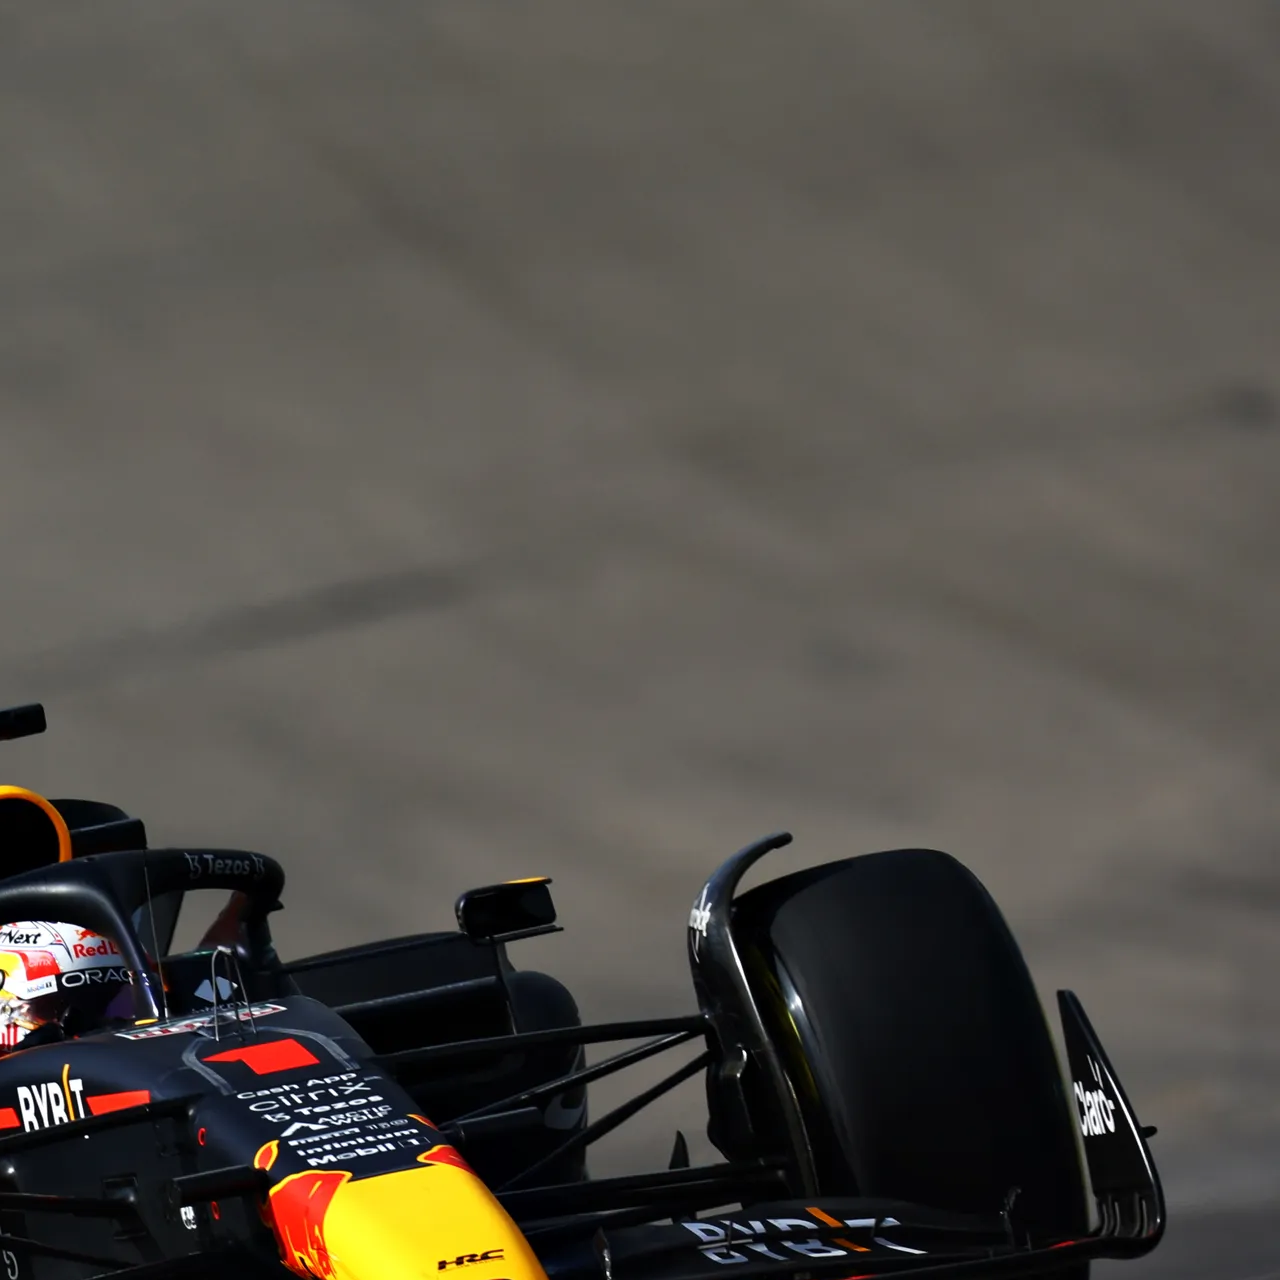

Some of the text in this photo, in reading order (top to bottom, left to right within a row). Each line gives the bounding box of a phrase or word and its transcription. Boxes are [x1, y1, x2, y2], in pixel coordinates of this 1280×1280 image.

[203, 854, 251, 875] Tezos
[73, 940, 108, 958] Red
[62, 968, 129, 988] ORAC
[237, 1084, 300, 1099] Cash
[306, 1072, 358, 1086] App
[294, 1095, 384, 1116] Tezos
[317, 1105, 393, 1124] ARCTIC
[1073, 1080, 1116, 1137] Claro
[329, 1110, 389, 1126] WOLF
[306, 1142, 397, 1167] Mobil
[682, 1207, 929, 1265] BYBIT
[437, 1249, 504, 1271] HRC
